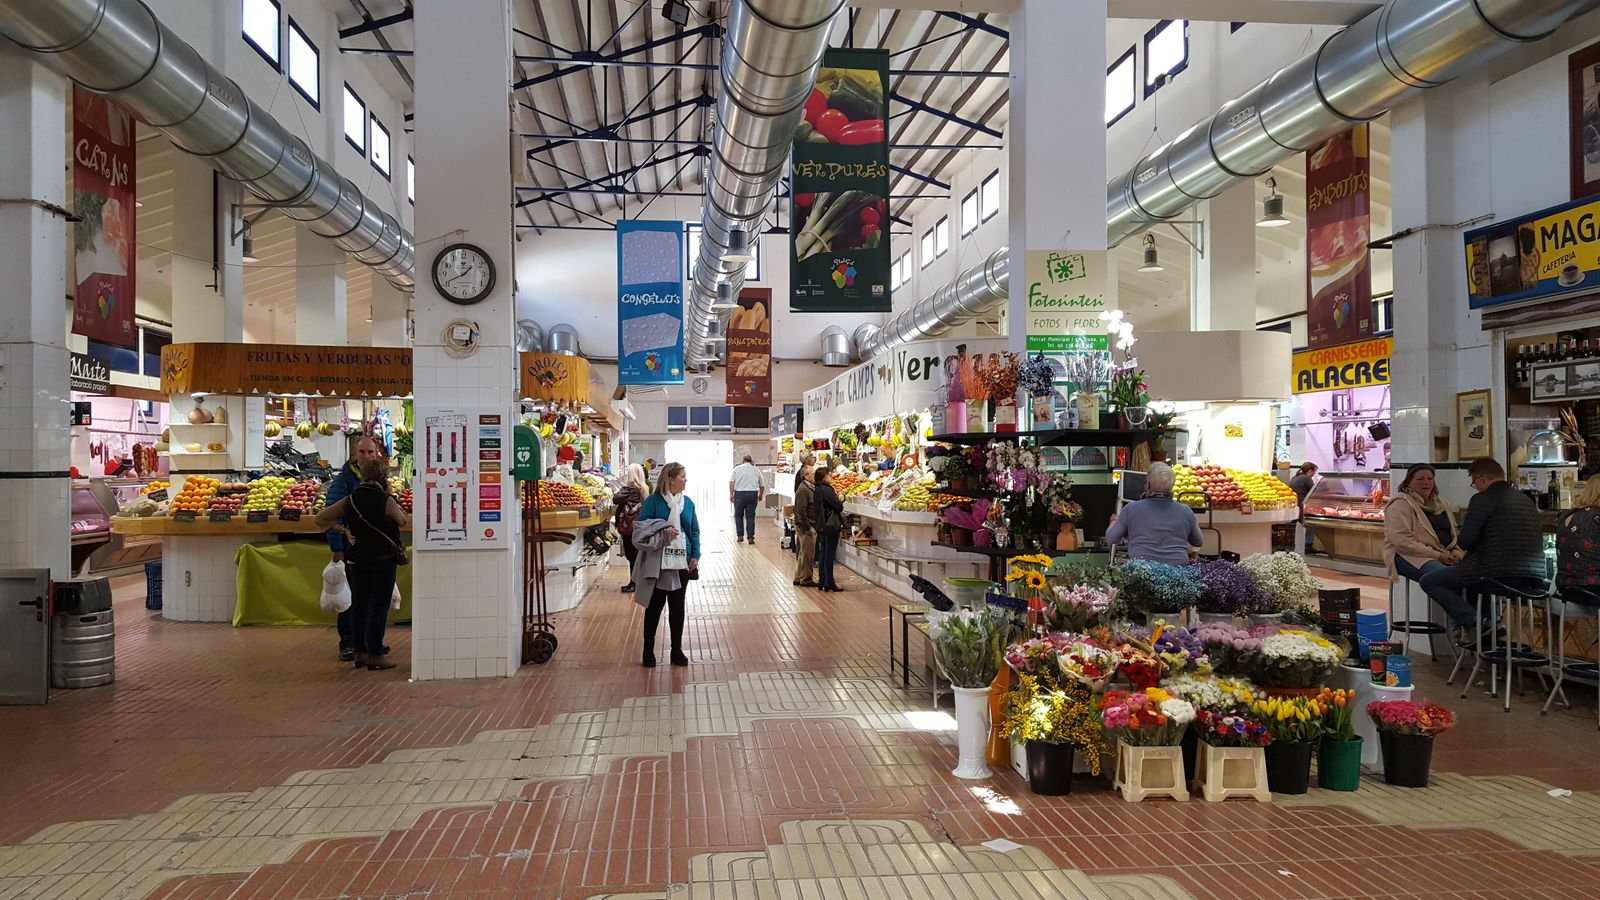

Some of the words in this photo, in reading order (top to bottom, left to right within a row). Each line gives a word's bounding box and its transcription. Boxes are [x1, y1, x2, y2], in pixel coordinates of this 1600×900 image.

[76, 139, 129, 187] CARNS
[791, 159, 888, 180] VERDURES
[1309, 171, 1368, 211] EMBOTITS
[1542, 251, 1576, 273] CAFETERIA
[621, 292, 681, 305] CONGELATS
[1034, 318, 1060, 329] FOTOS
[1073, 318, 1101, 329] FLORS
[247, 351, 299, 364] FRUTAS
[305, 352, 313, 364] Y
[317, 353, 391, 366] VERDURAS
[1309, 341, 1388, 366] CARNISSERIA
[70, 356, 107, 380] Maite
[528, 357, 568, 380] OROZCO
[898, 350, 940, 382] Ver
[1297, 358, 1391, 391] ALACRE
[249, 374, 280, 383] TIENDA
[847, 363, 875, 402] CAMPS
